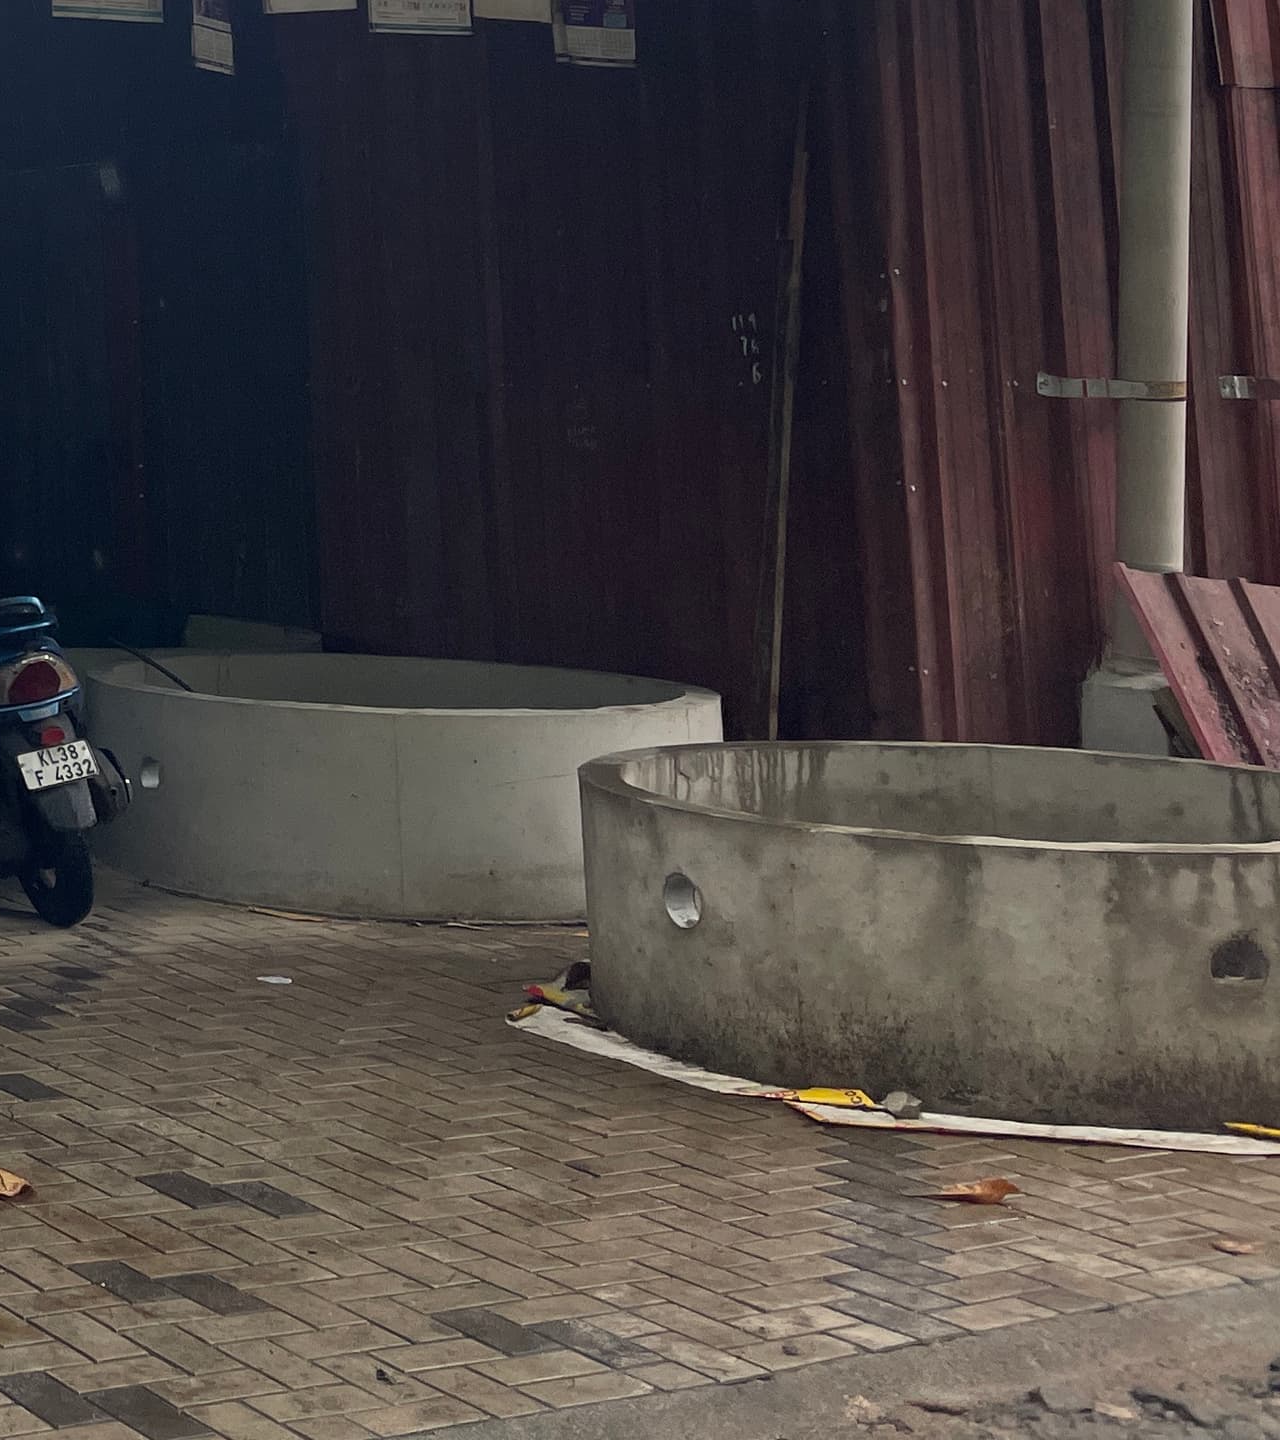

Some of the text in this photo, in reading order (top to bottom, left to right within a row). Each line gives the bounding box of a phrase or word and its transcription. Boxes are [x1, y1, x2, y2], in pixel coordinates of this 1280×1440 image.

[37, 744, 79, 767] KL38
[35, 759, 95, 787] F 4332
